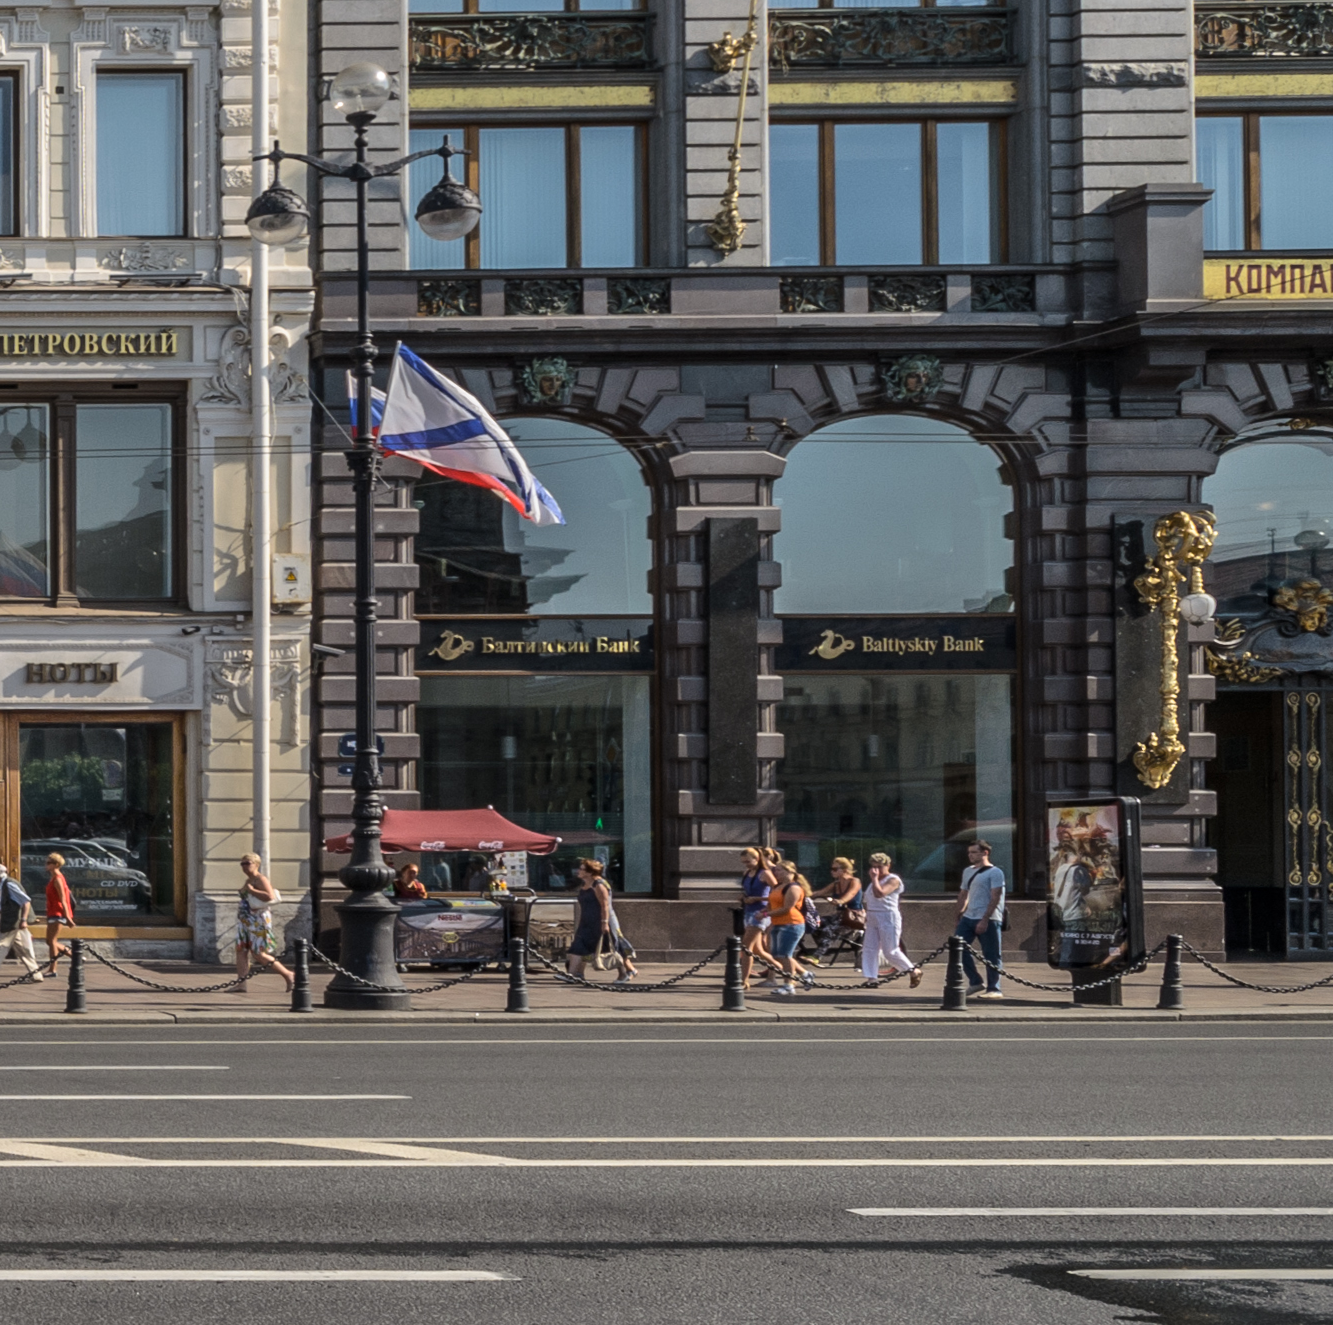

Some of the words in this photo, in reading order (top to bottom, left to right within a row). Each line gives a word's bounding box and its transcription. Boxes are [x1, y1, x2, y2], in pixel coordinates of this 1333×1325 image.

[596, 636, 640, 653] Банк
[862, 636, 938, 656] Baltiyskiy
[943, 635, 984, 652] Bank
[26, 662, 119, 684] НОТЫ
[76, 888, 119, 898] НОТЫ
